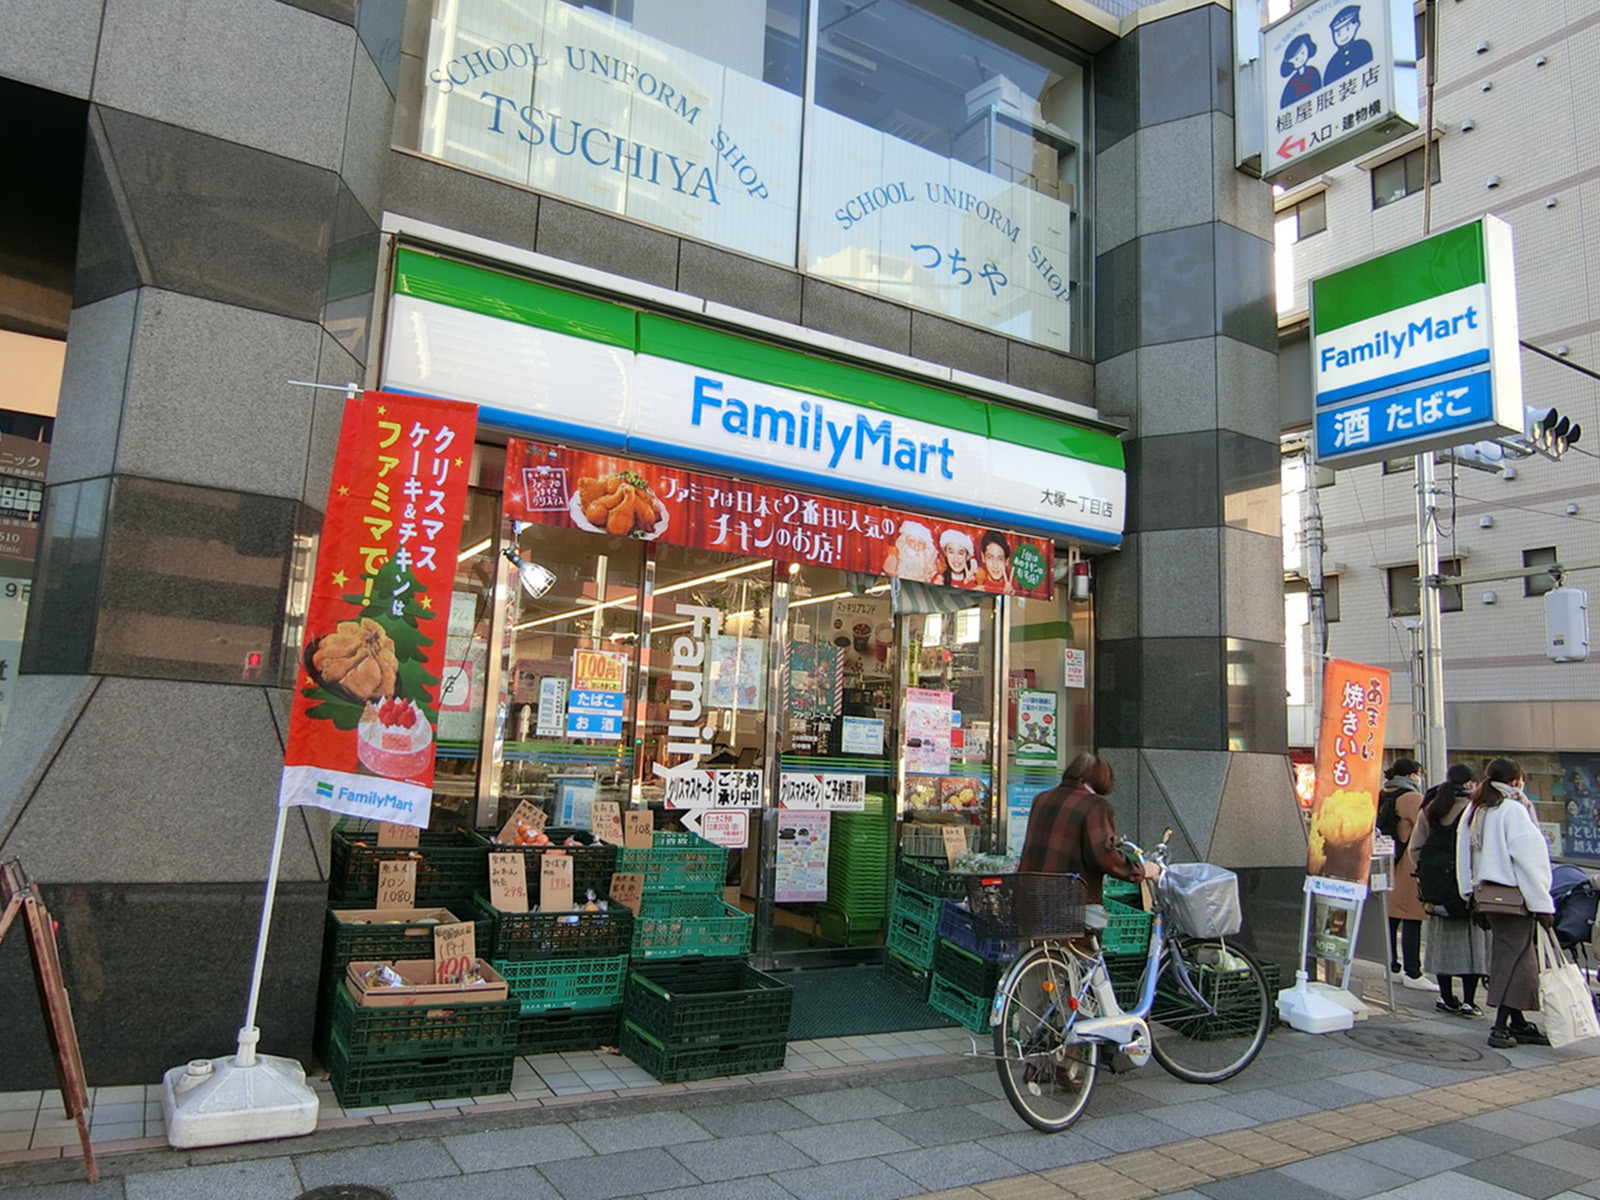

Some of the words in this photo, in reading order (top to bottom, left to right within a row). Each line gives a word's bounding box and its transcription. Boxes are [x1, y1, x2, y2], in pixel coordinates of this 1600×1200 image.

[430, 42, 548, 95] SCHOOL
[565, 45, 702, 126] UNIFORM
[710, 129, 769, 200] SHOP
[1276, 65, 1380, 133] 槌屋服装店
[480, 90, 721, 206] TSUCHIYA
[835, 182, 915, 230] SCHOOL
[925, 182, 1021, 243] UNIFORM
[1027, 246, 1071, 302] SHOP
[910, 243, 1008, 296] つちや
[1321, 305, 1478, 372] FamilyMart
[691, 376, 954, 480] FamilyMart
[1334, 407, 1370, 448] 酒
[1387, 387, 1472, 432] たばこ
[392, 421, 430, 616] ケーキ&チキンは
[416, 425, 456, 571] クリスマス
[660, 476, 894, 540] ファミマは日本で2番目に人気の
[1040, 488, 1113, 518] 大塚一丁目店
[577, 692, 615, 708] たばこ
[1332, 681, 1365, 786] 焼きいも
[338, 787, 414, 813] FamilyMart
[719, 772, 759, 788] ご予約
